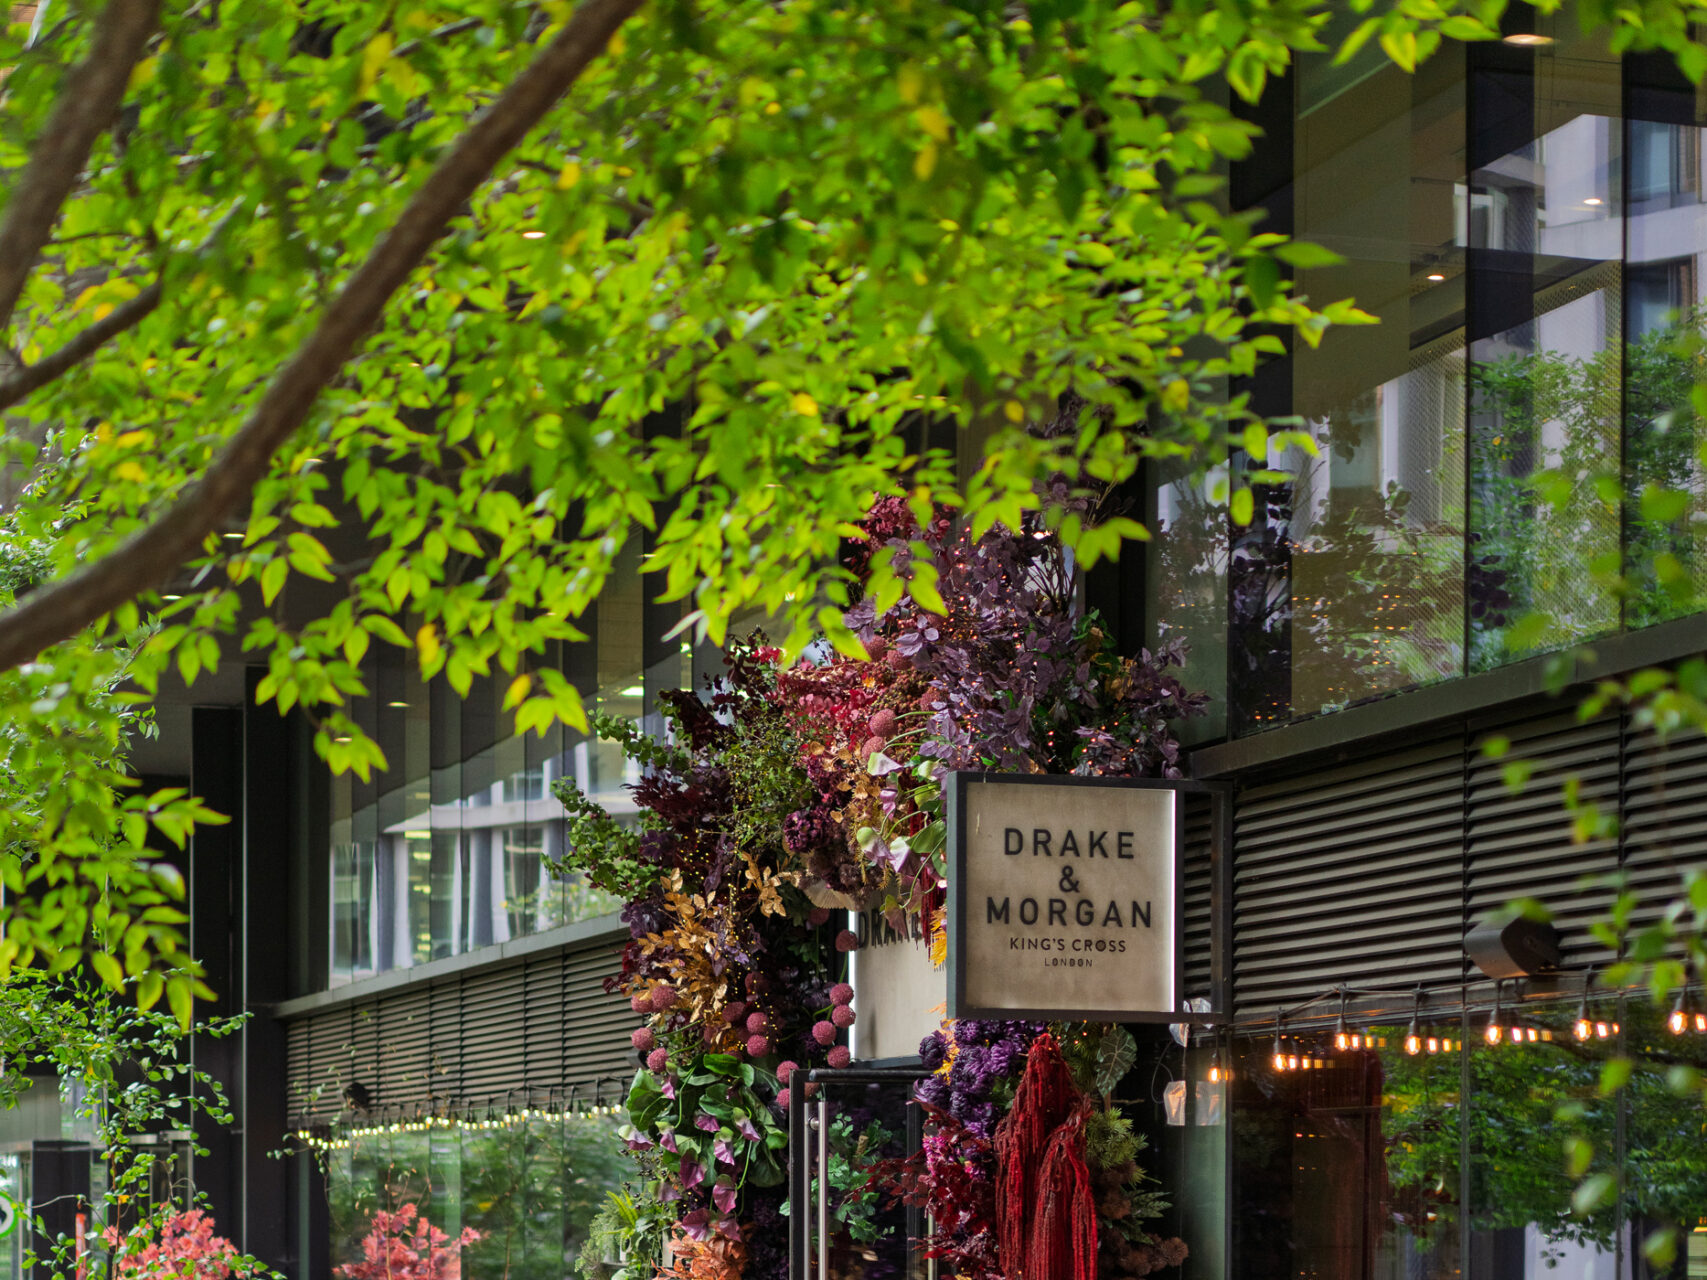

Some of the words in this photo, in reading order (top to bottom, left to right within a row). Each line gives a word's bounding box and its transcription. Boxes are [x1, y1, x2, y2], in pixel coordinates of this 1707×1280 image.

[1003, 827, 1135, 860] DRAKE
[1058, 865, 1081, 893] &
[986, 896, 1152, 928] MORGAN
[1009, 937, 1065, 951] KING'S
[1071, 938, 1127, 952] CROSS
[1044, 957, 1093, 968] LONDON
